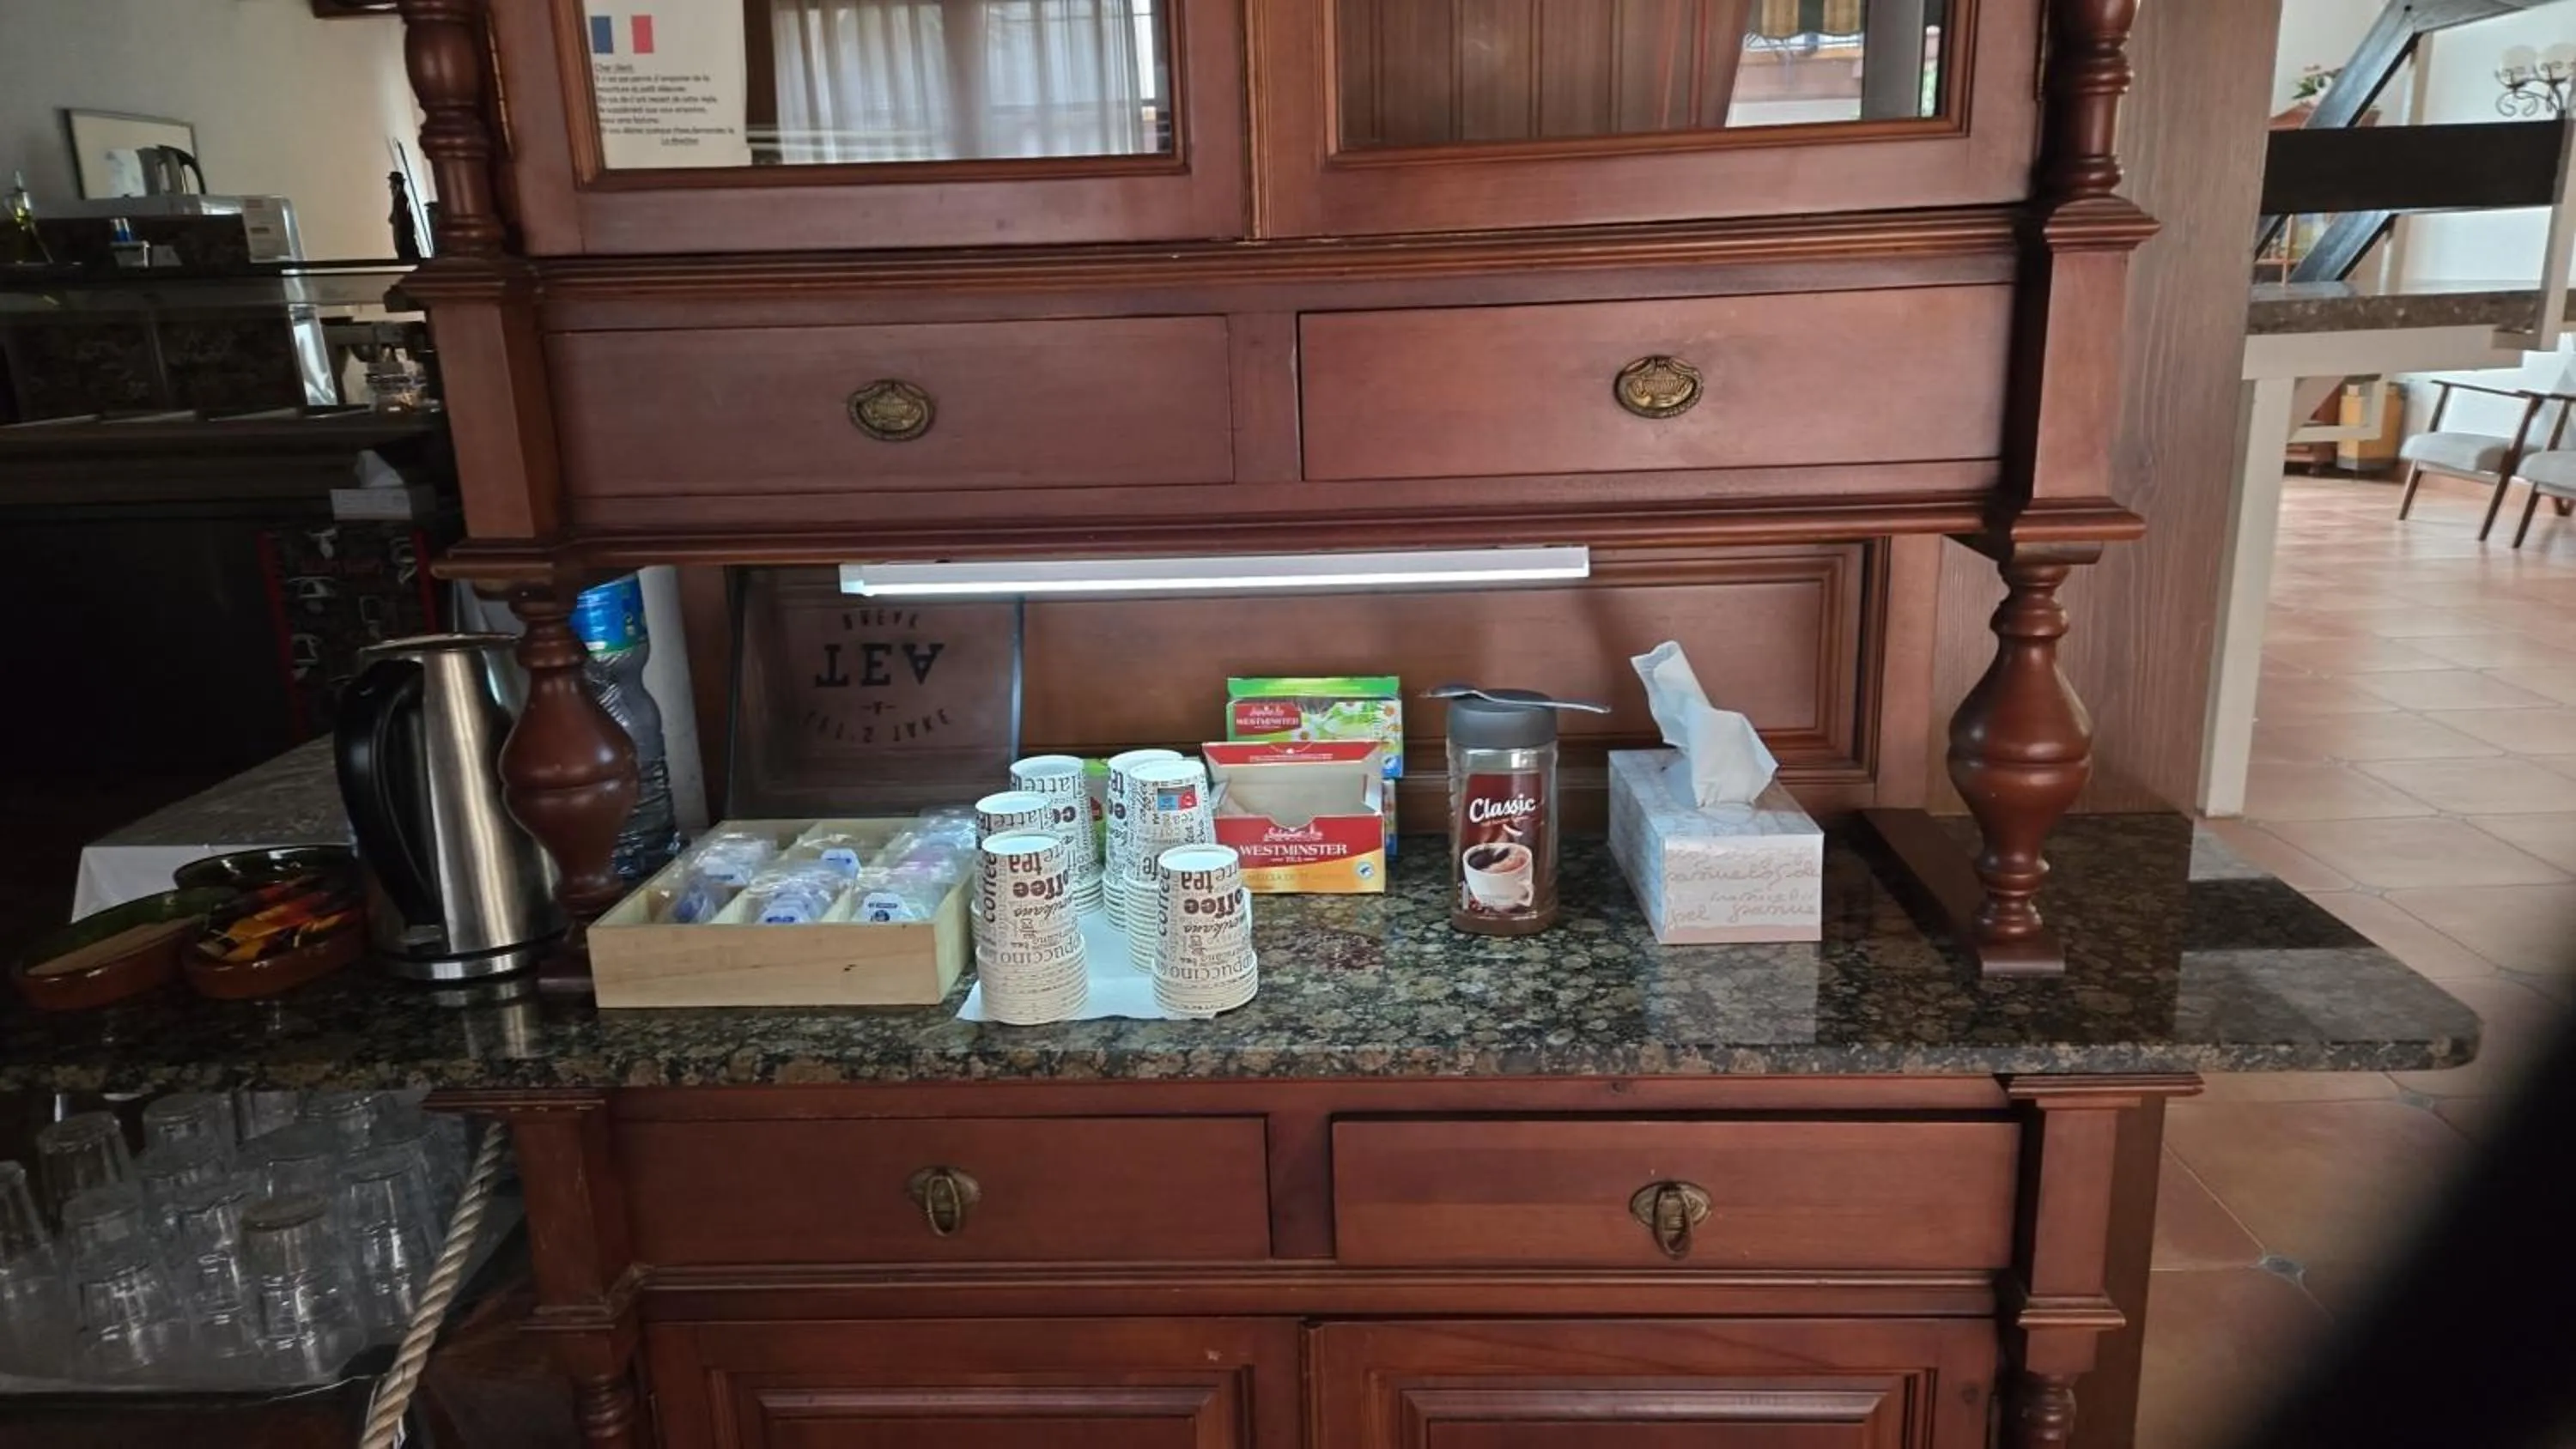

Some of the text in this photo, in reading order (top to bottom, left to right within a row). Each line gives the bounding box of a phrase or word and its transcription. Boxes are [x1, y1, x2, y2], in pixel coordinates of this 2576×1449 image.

[1469, 793, 1535, 823] Classic
[1239, 844, 1347, 856] WESTMINSTER
[1008, 852, 1042, 876] tea
[1012, 869, 1069, 900] offee
[1181, 870, 1213, 894] tea
[1184, 888, 1243, 919] offee
